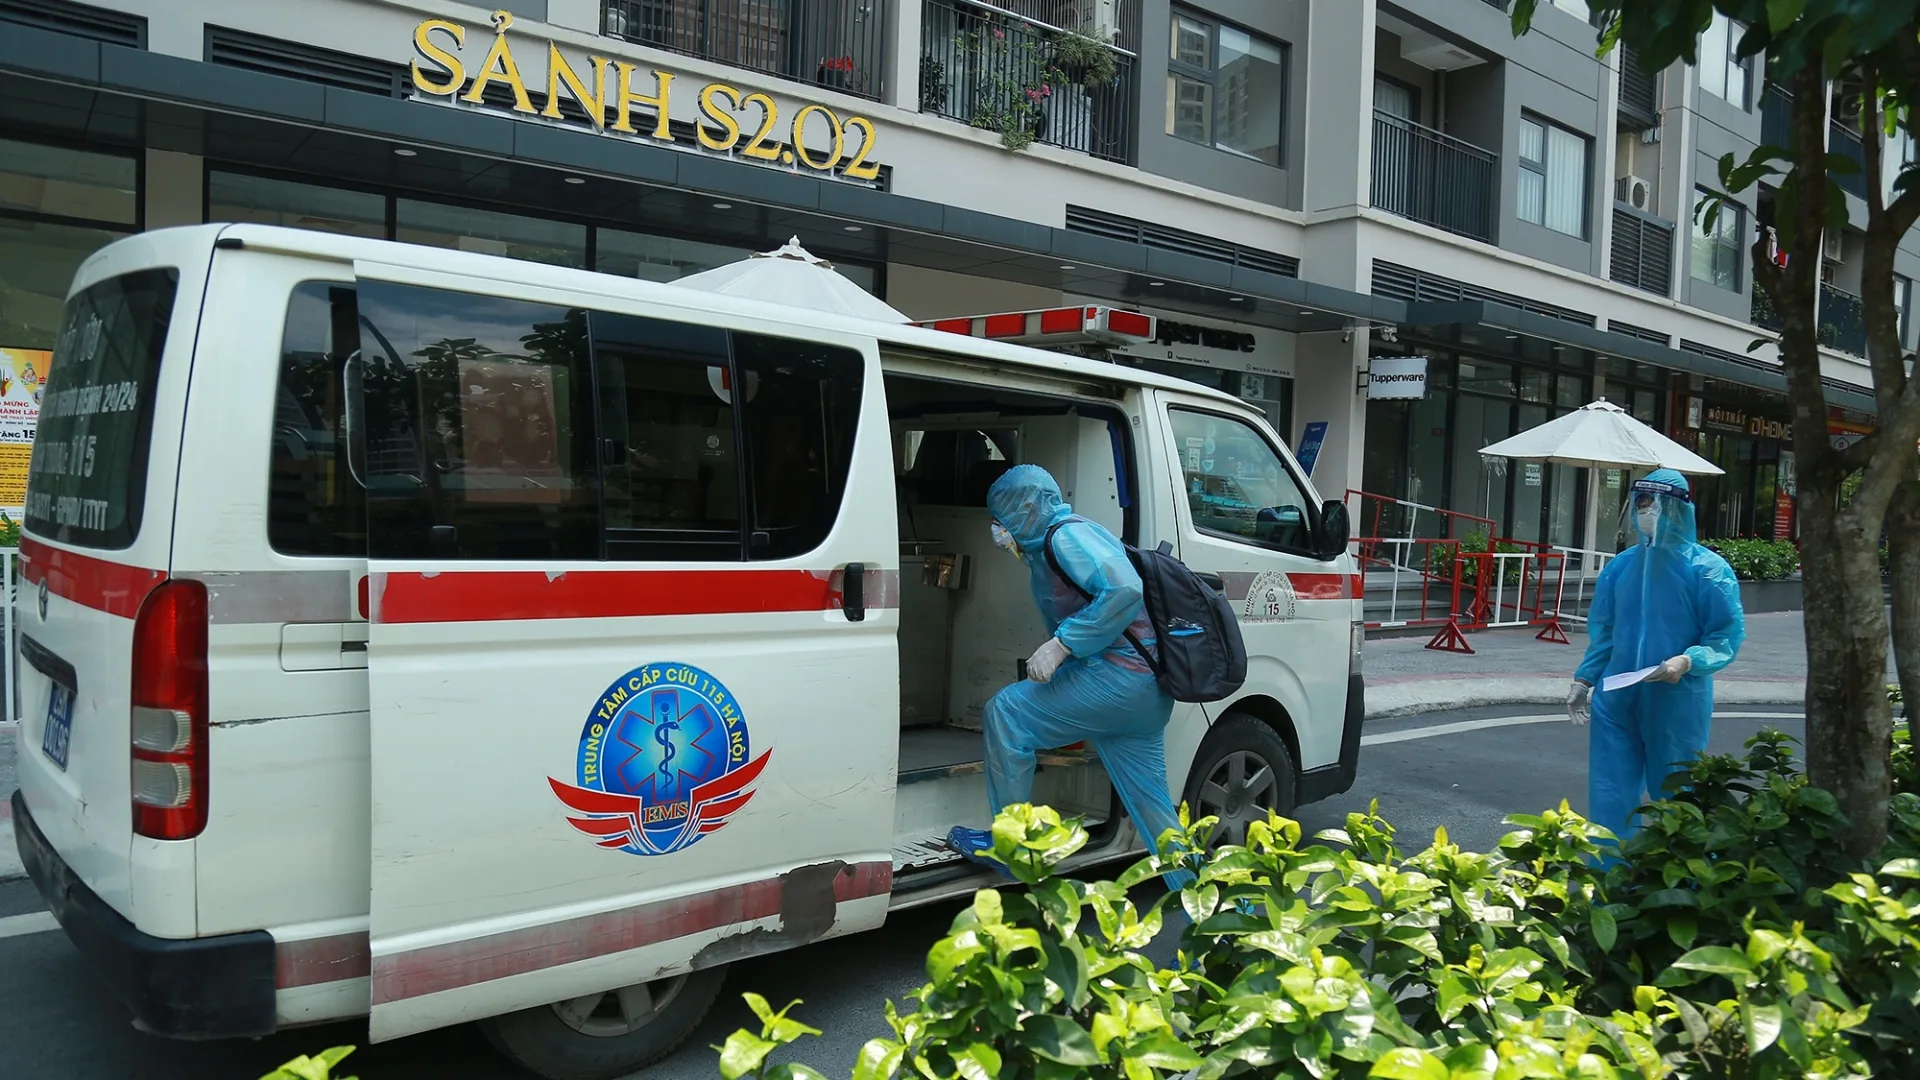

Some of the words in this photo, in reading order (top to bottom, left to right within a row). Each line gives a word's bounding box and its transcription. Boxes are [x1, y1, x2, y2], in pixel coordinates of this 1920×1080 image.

[408, 9, 676, 142] SẢNH
[1369, 373, 1425, 384] Tupperware
[101, 381, 138, 413] 24/24
[70, 435, 97, 478] 115
[1262, 603, 1280, 616] 115
[628, 665, 661, 691] CẤP
[665, 666, 699, 687] CỨU
[597, 686, 629, 721] TÂM
[701, 679, 726, 706] 115
[721, 703, 741, 728] HÀ
[584, 723, 605, 785] TRUNG
[730, 731, 747, 763] NỘI
[642, 801, 690, 824] EMS
